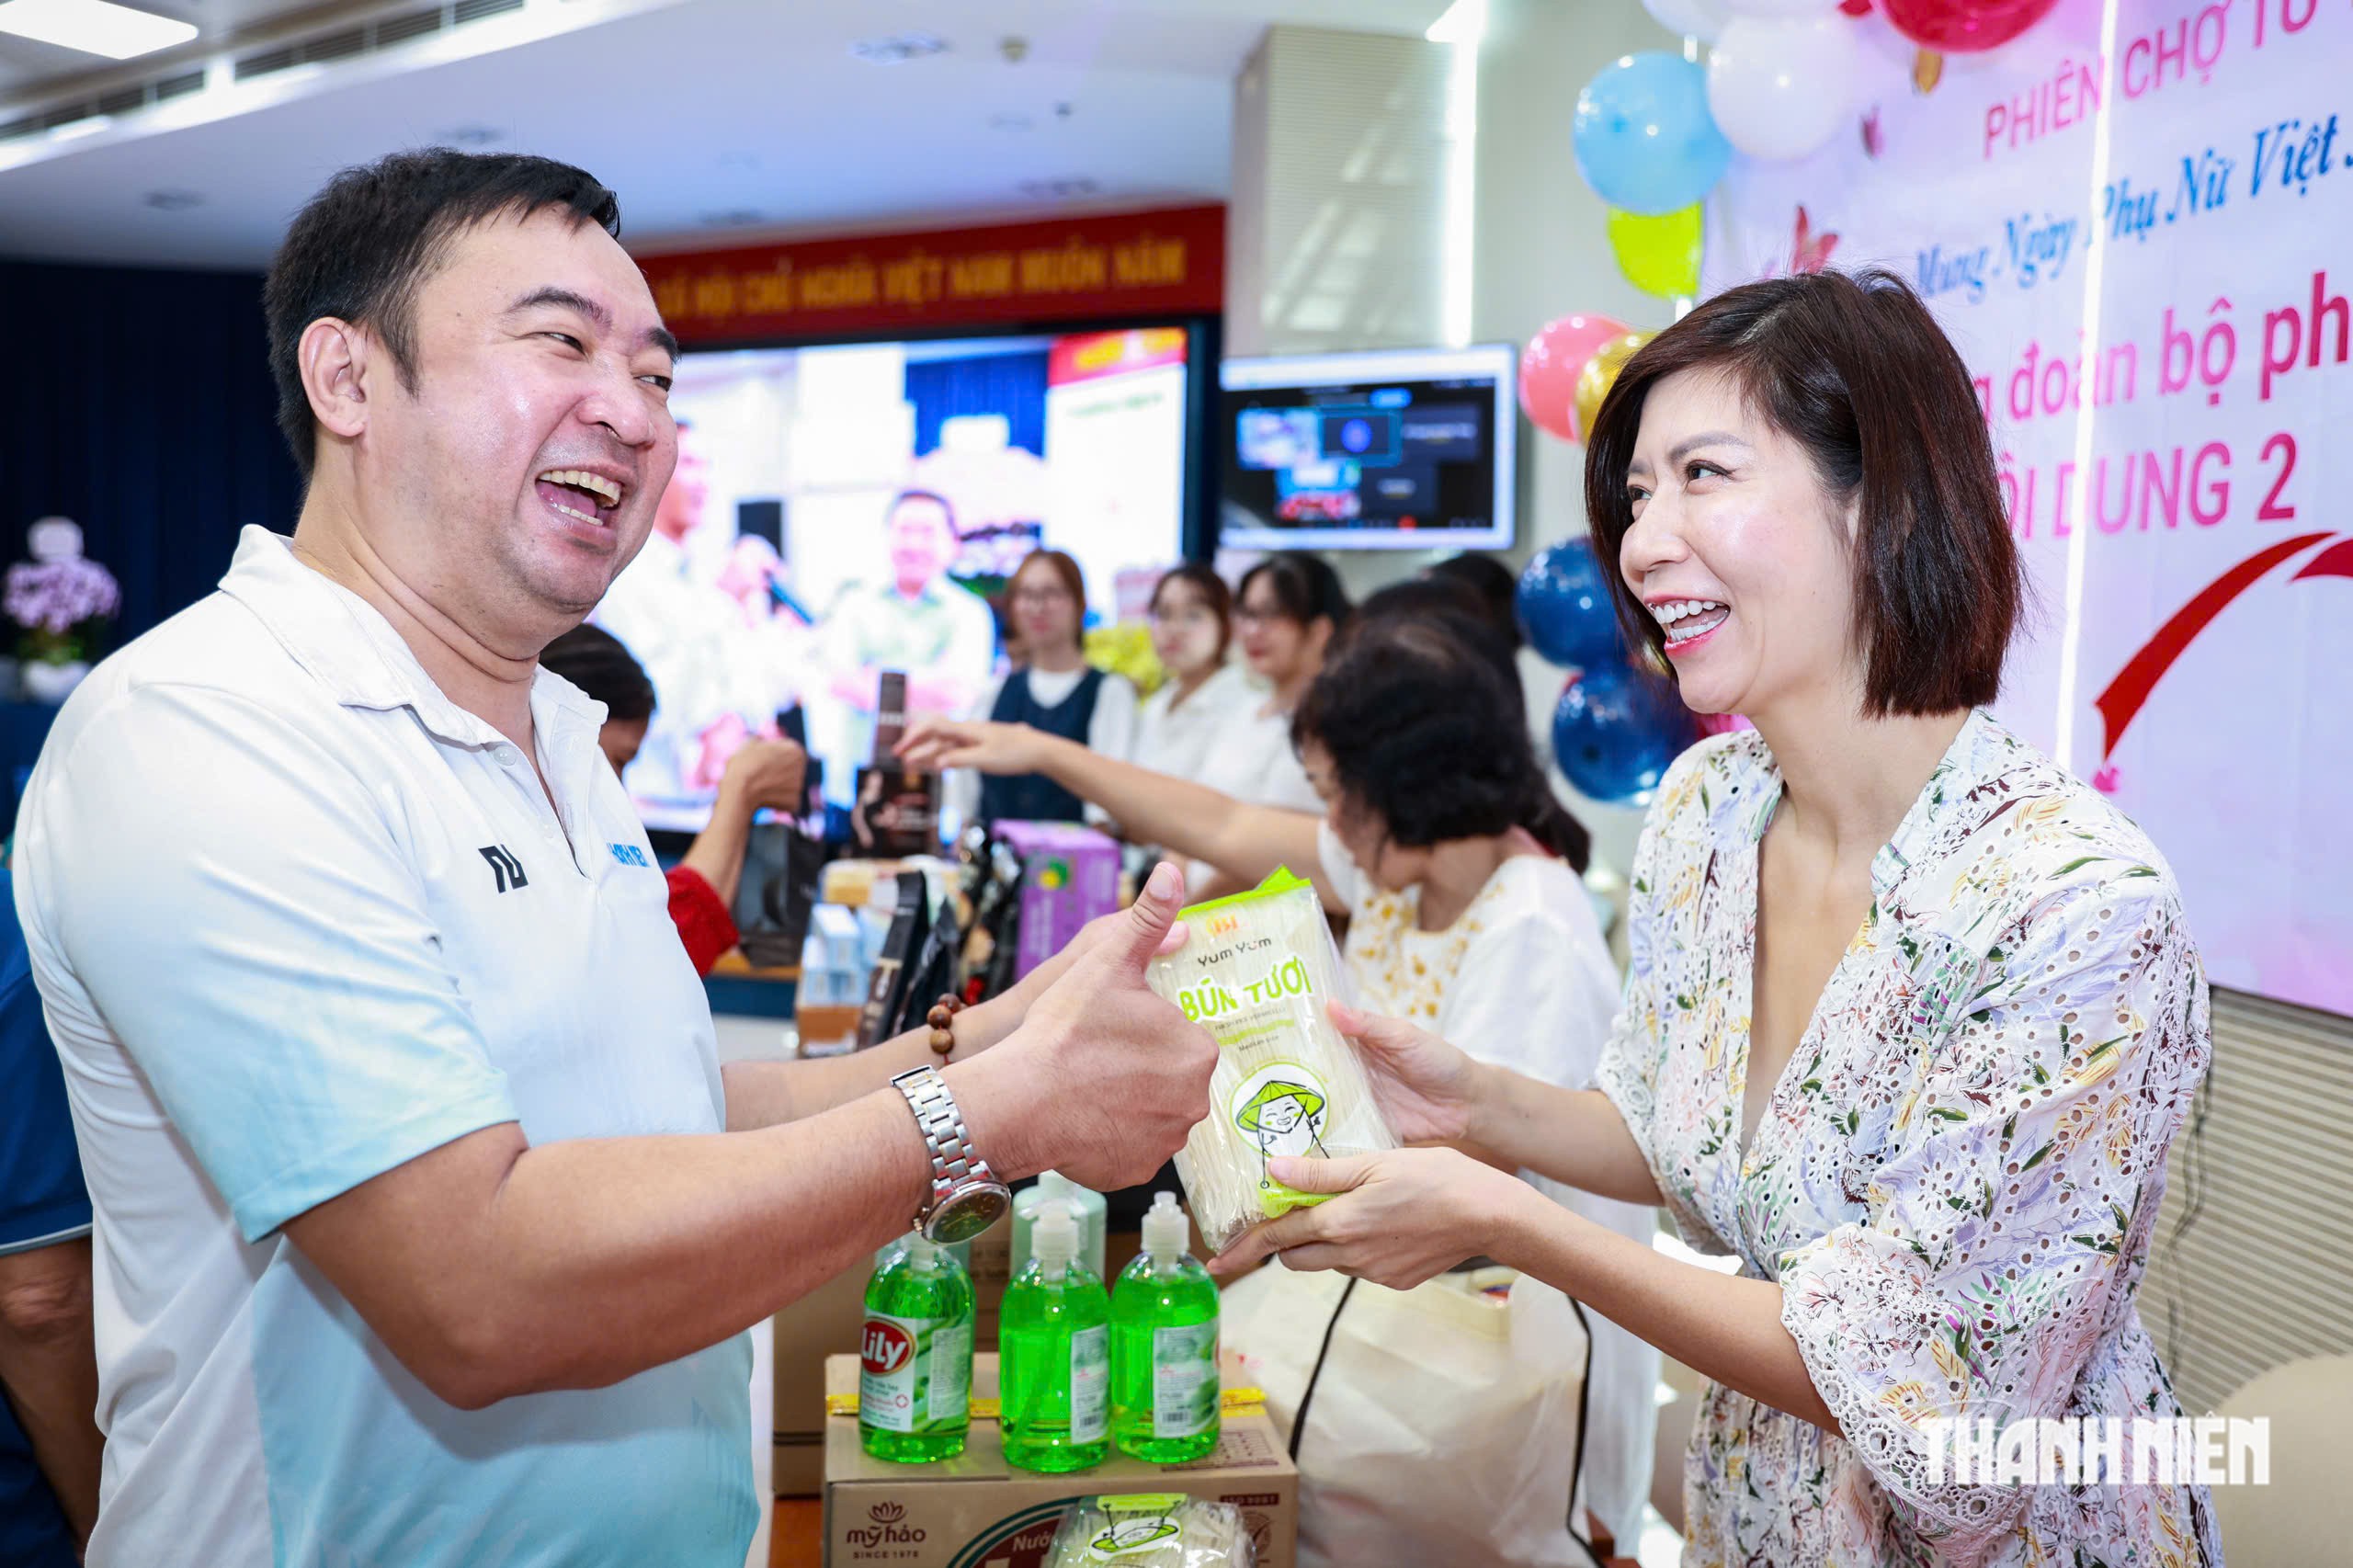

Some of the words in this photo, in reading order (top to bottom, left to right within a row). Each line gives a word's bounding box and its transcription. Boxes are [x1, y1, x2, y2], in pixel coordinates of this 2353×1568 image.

[1984, 55, 2105, 160] PHIÊN
[2122, 0, 2232, 98] CHỢ
[2164, 147, 2235, 224] Nữ
[2250, 114, 2337, 197] Việt
[2159, 297, 2236, 406] bộ
[2256, 432, 2298, 522] 2
[1178, 977, 1239, 1022] BÚN
[1243, 956, 1313, 1004] TƯƠI
[860, 1327, 908, 1370] Lily
[853, 1551, 889, 1559] SINCE
[1012, 1532, 1051, 1552] Nướ
